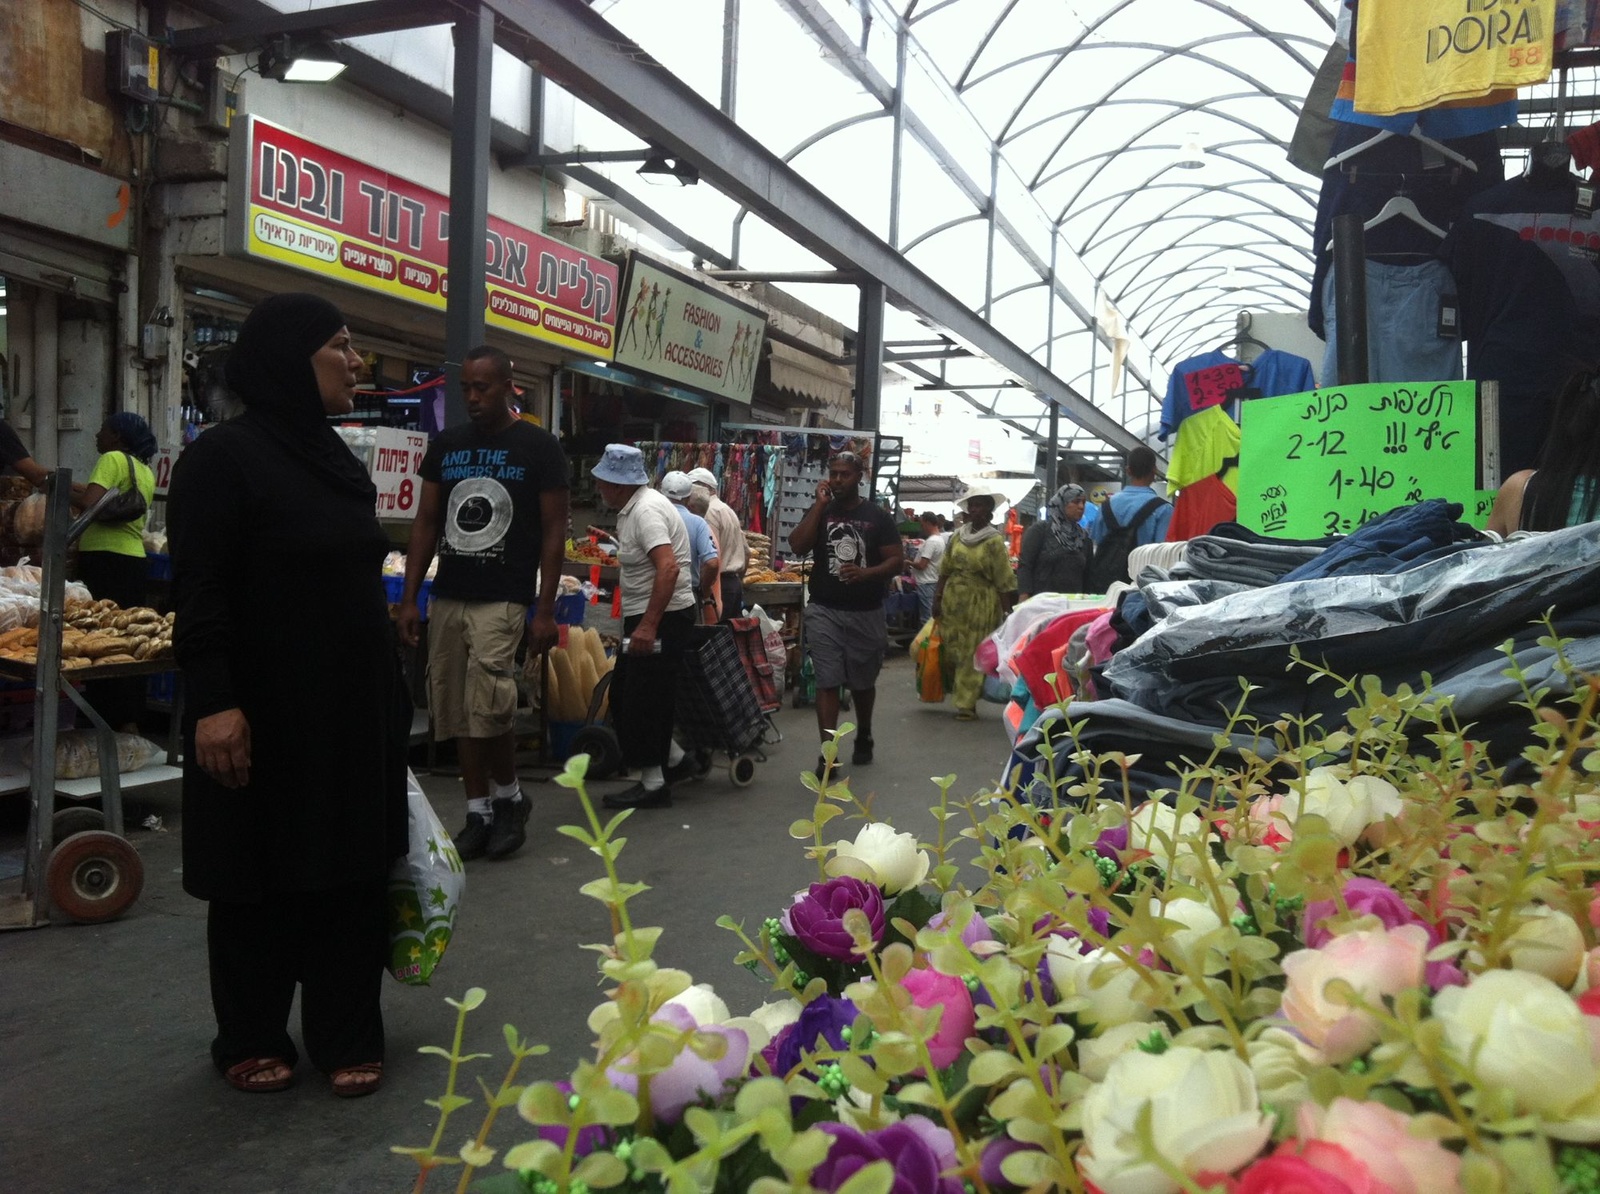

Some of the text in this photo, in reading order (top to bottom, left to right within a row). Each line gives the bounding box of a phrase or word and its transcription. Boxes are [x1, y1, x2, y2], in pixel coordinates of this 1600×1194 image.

[1426, 6, 1544, 64] DORA
[1508, 46, 1542, 67] 58
[259, 141, 345, 225] ובנו
[359, 180, 426, 251] דוד
[536, 251, 612, 323] קליית
[683, 302, 721, 334] FASHION
[694, 330, 703, 349] &
[665, 342, 724, 379] ACCESSORIES
[1370, 384, 1453, 417] חליפות
[376, 448, 409, 473] פיתות
[441, 449, 509, 467] AND THE
[1286, 431, 1347, 460] 2-12
[156, 456, 170, 487] 12
[496, 466, 526, 481] ARE
[397, 479, 413, 511] 8
